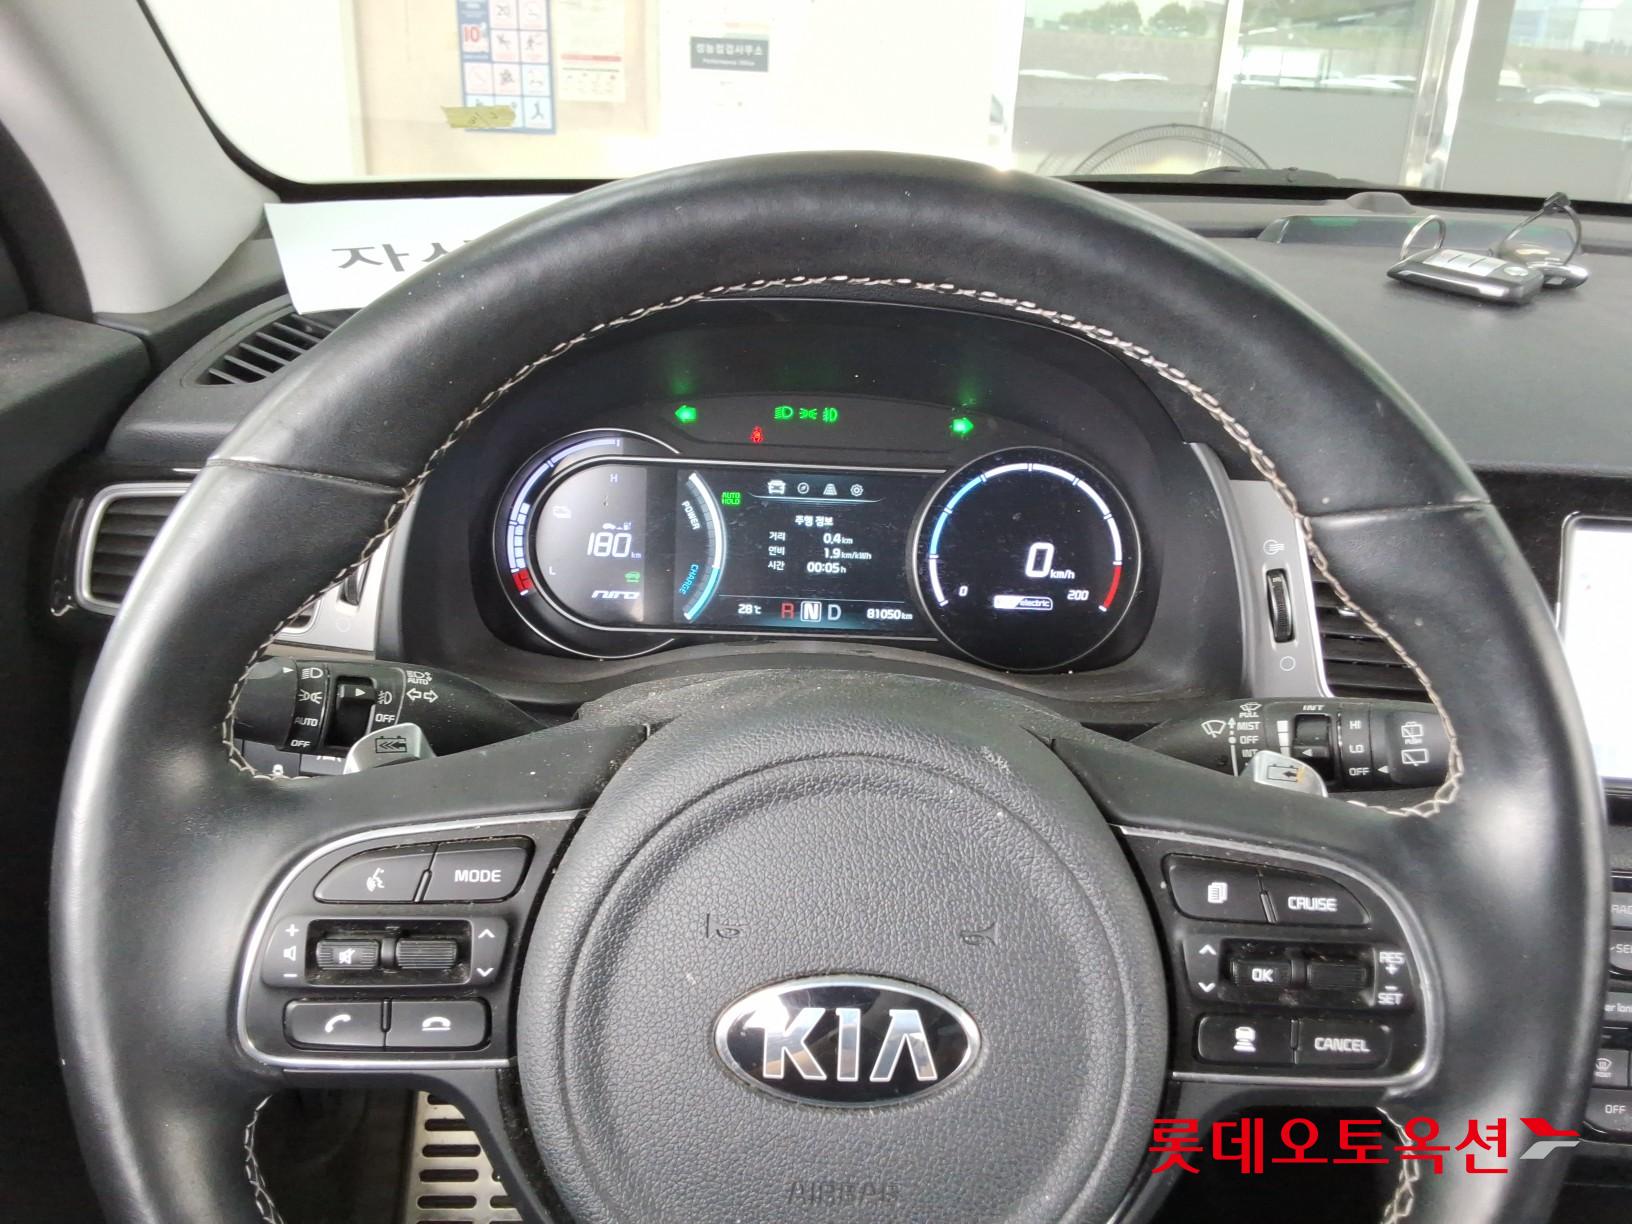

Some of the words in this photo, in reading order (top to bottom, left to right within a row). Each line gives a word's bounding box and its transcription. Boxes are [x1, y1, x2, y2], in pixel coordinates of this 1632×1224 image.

[609, 473, 619, 483] H
[721, 491, 742, 499] AUTO
[681, 500, 701, 531] POWER
[794, 515, 814, 528] 주행
[815, 516, 834, 528] 정보
[768, 531, 786, 542] 거리
[767, 560, 785, 571] 시간
[1025, 542, 1054, 578] 0
[1050, 569, 1075, 580] km/h
[548, 565, 557, 576] L
[679, 563, 699, 595] CHARGE
[958, 585, 969, 597] 0
[1067, 589, 1090, 601] 200
[781, 602, 795, 619] R
[803, 603, 819, 620] N
[827, 604, 842, 621] D
[407, 677, 429, 686] AUTO
[1303, 704, 1325, 712] INT
[375, 713, 396, 724] OFF
[1239, 711, 1260, 719] PULL
[295, 717, 319, 728] AUTO
[1237, 721, 1261, 731] MIST
[1349, 719, 1362, 730] HI
[290, 739, 311, 749] OFF
[1239, 735, 1259, 745] OFF
[1349, 743, 1364, 754] LO
[1349, 767, 1369, 777] OFF
[454, 869, 502, 883] MODE
[1287, 896, 1338, 912] CRUISE
[1379, 951, 1404, 964] RES
[1251, 968, 1273, 983] OK
[1378, 992, 1403, 1005] SET
[757, 1007, 938, 1082] KIA
[1314, 1037, 1370, 1052] CANCEL
[1605, 1103, 1626, 1115] OFF
